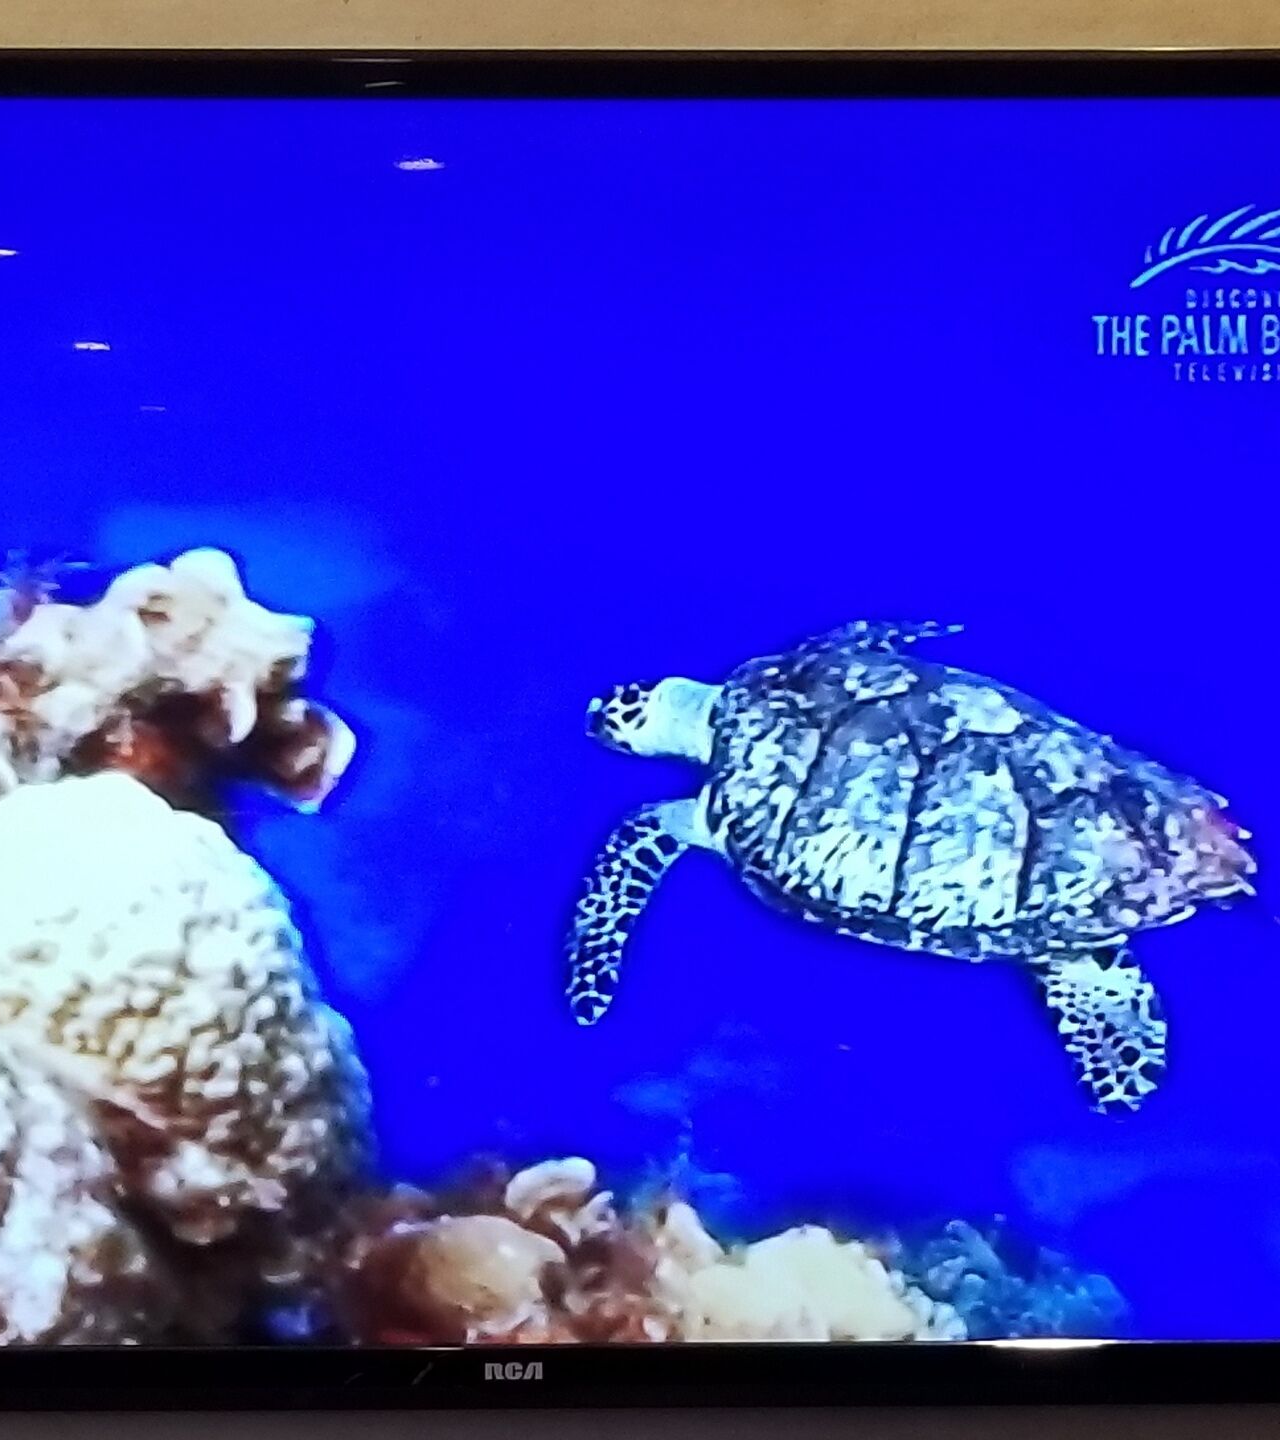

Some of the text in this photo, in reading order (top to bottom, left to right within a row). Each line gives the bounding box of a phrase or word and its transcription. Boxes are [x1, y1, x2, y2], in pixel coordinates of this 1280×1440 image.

[1092, 315, 1151, 357] THE
[1161, 315, 1249, 356] PALM
[484, 1361, 544, 1381] RCA
